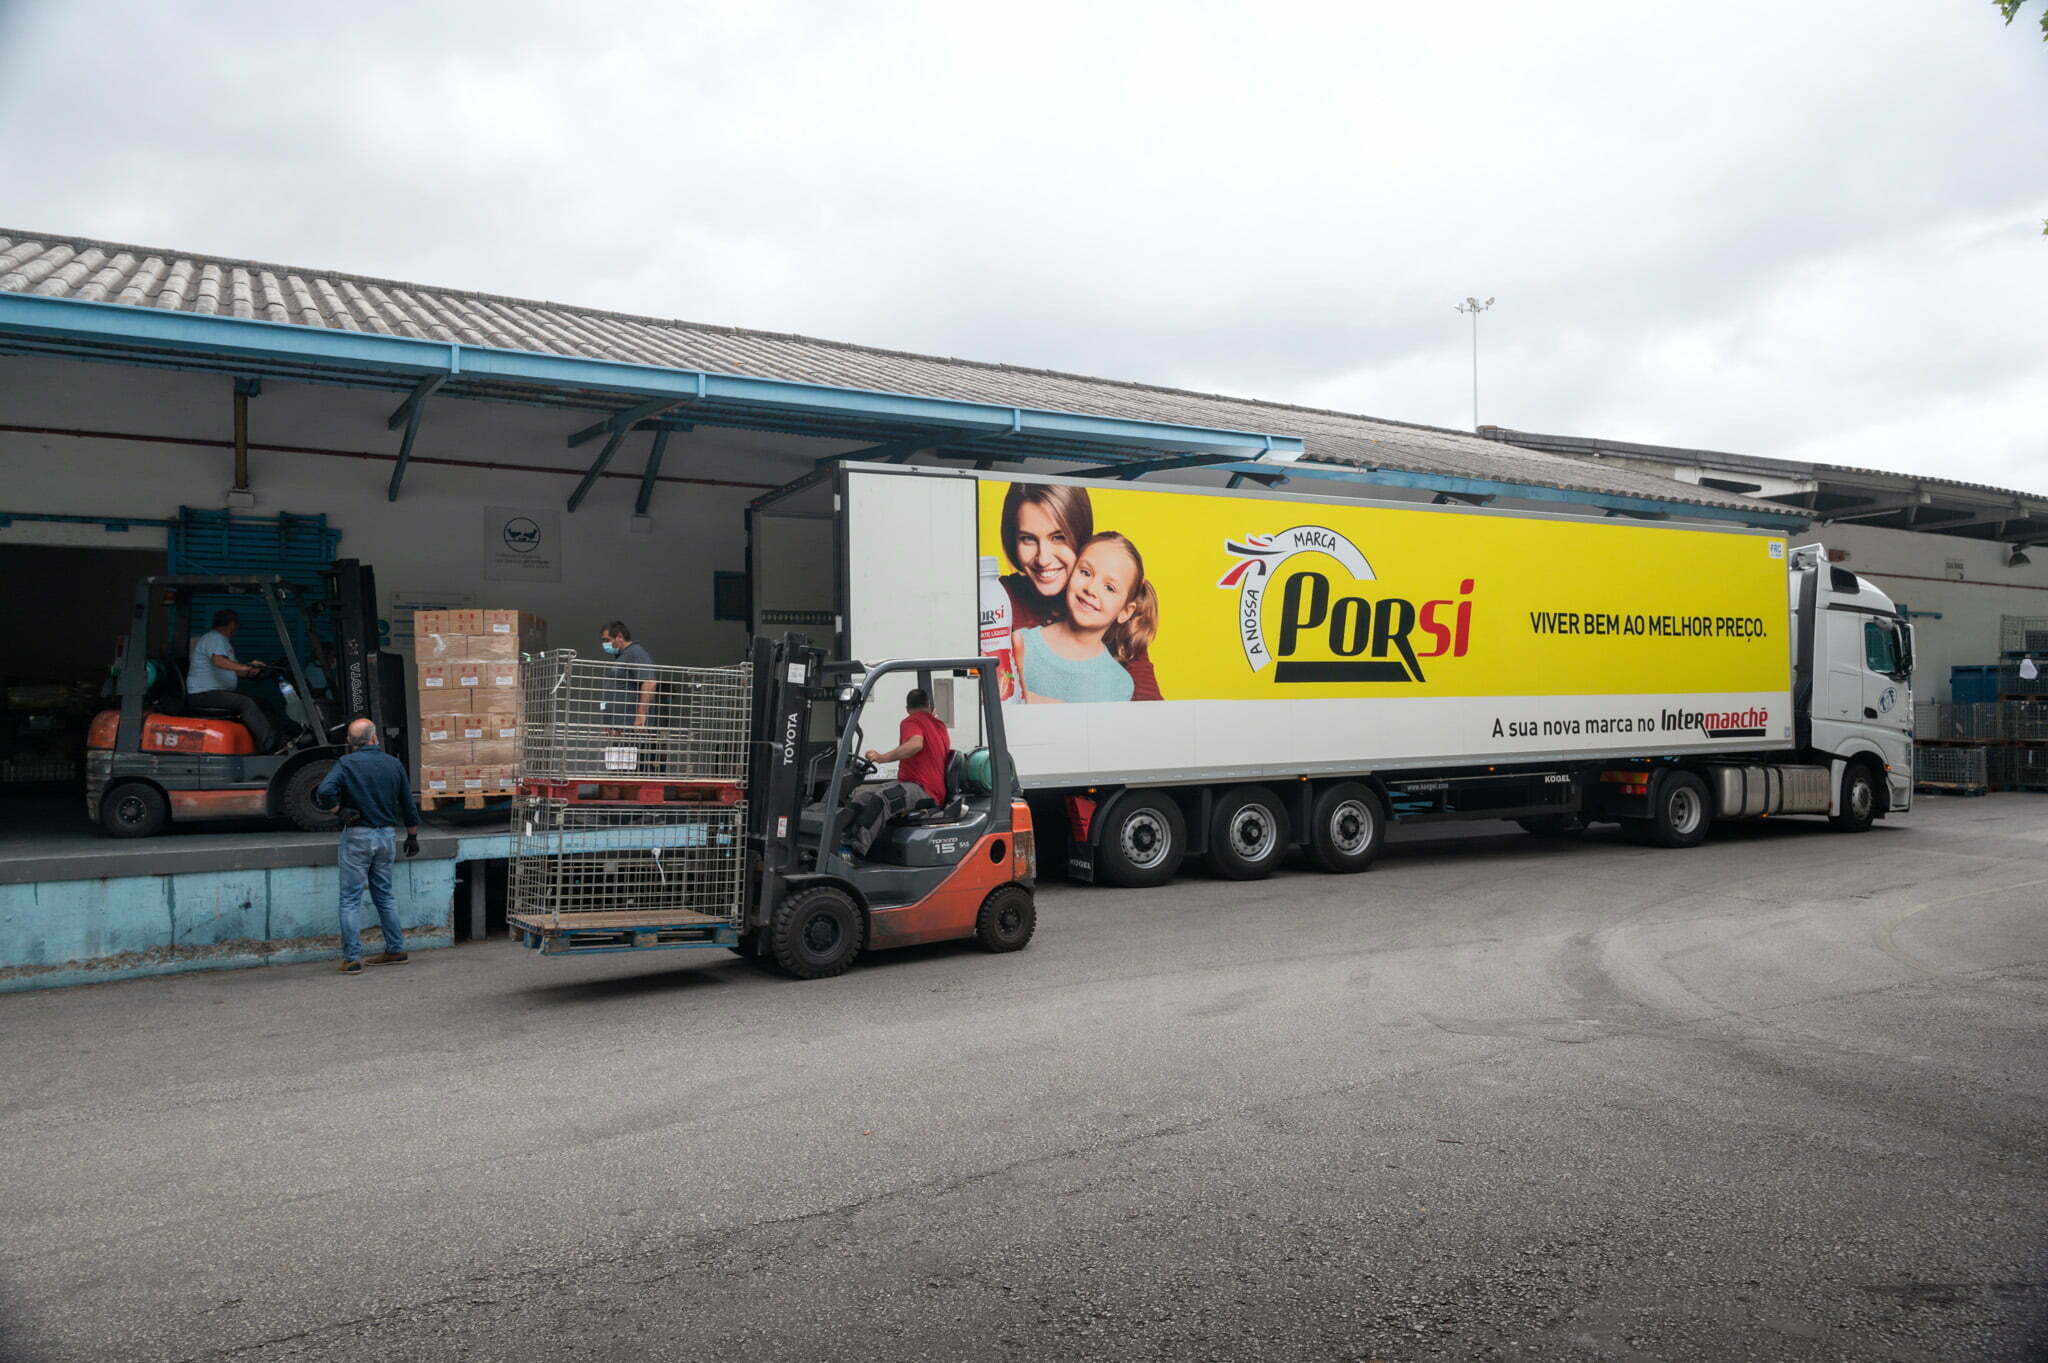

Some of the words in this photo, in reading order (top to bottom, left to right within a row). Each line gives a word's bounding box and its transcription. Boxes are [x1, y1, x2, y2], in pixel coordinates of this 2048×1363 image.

[1294, 531, 1336, 551] MARCA
[1246, 589, 1260, 642] NOSSA
[1530, 612, 1580, 634] VIVER
[1584, 613, 1619, 635] BEM
[1623, 615, 1645, 636] AO
[1649, 616, 1712, 637] MELHOR
[1716, 617, 1767, 642] PREÇO.
[1250, 644, 1263, 654] A
[351, 662, 363, 712] TOYOTA
[1492, 718, 1504, 738] A
[1509, 721, 1538, 737] sua
[1543, 719, 1580, 735] nova
[1585, 717, 1633, 734] marca
[1638, 717, 1655, 732] no
[155, 732, 178, 746] 18
[784, 713, 798, 766] TOYOTA
[934, 842, 955, 854] 15
